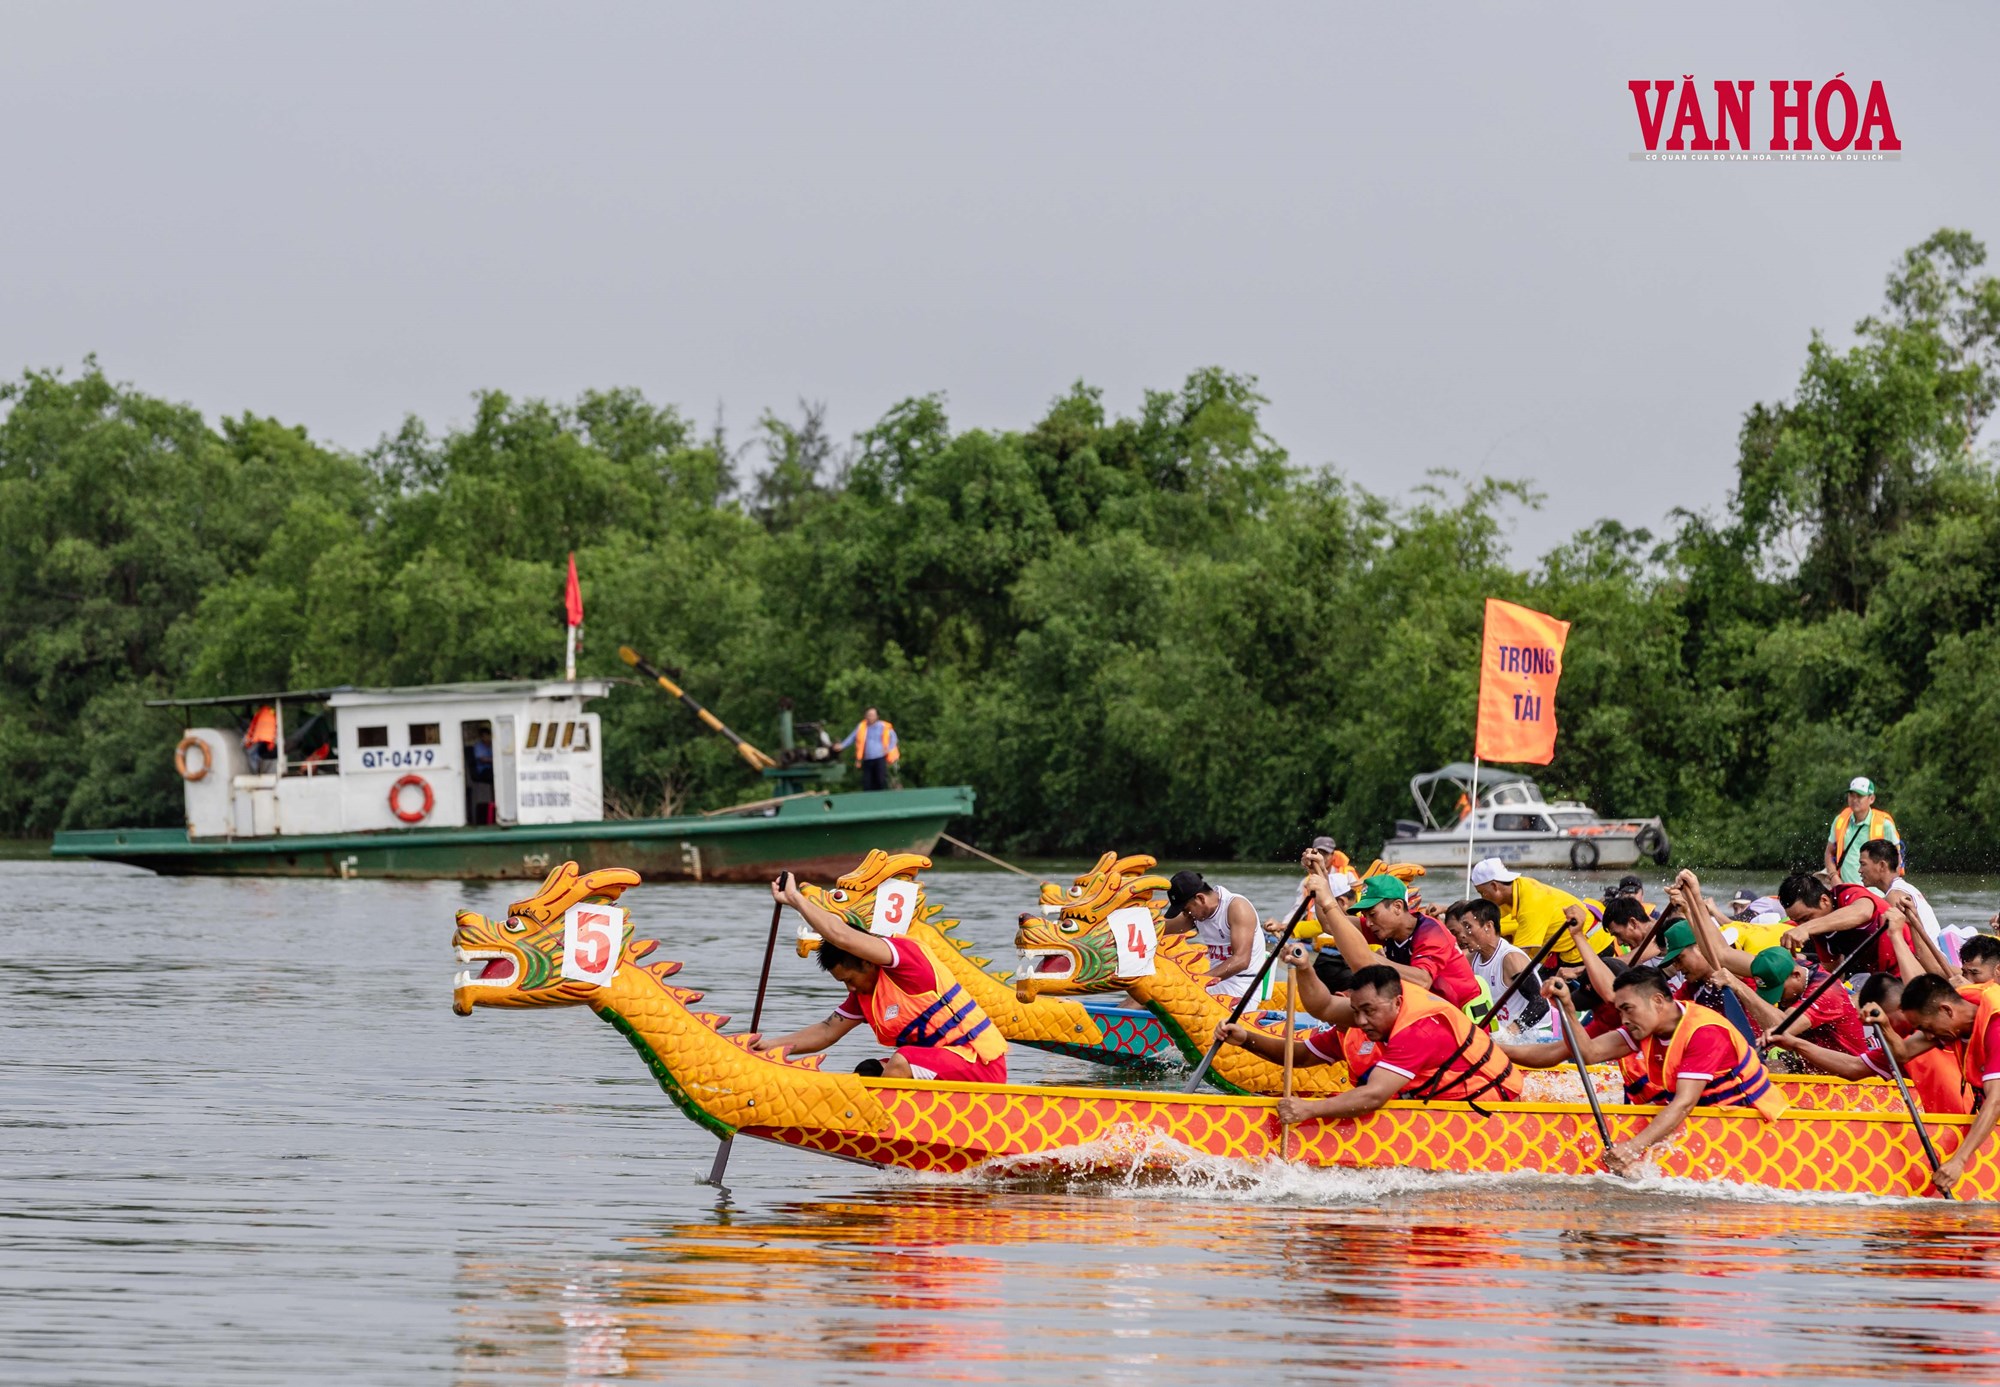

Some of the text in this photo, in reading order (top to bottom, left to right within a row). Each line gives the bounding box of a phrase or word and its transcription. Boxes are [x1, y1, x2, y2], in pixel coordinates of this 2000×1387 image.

[1499, 645, 1556, 680] TRỌNG
[1513, 689, 1541, 722] TÀI
[362, 749, 434, 768] QT-0479
[885, 892, 905, 924] 3
[575, 911, 611, 974] 5
[1127, 923, 1147, 959] 4
